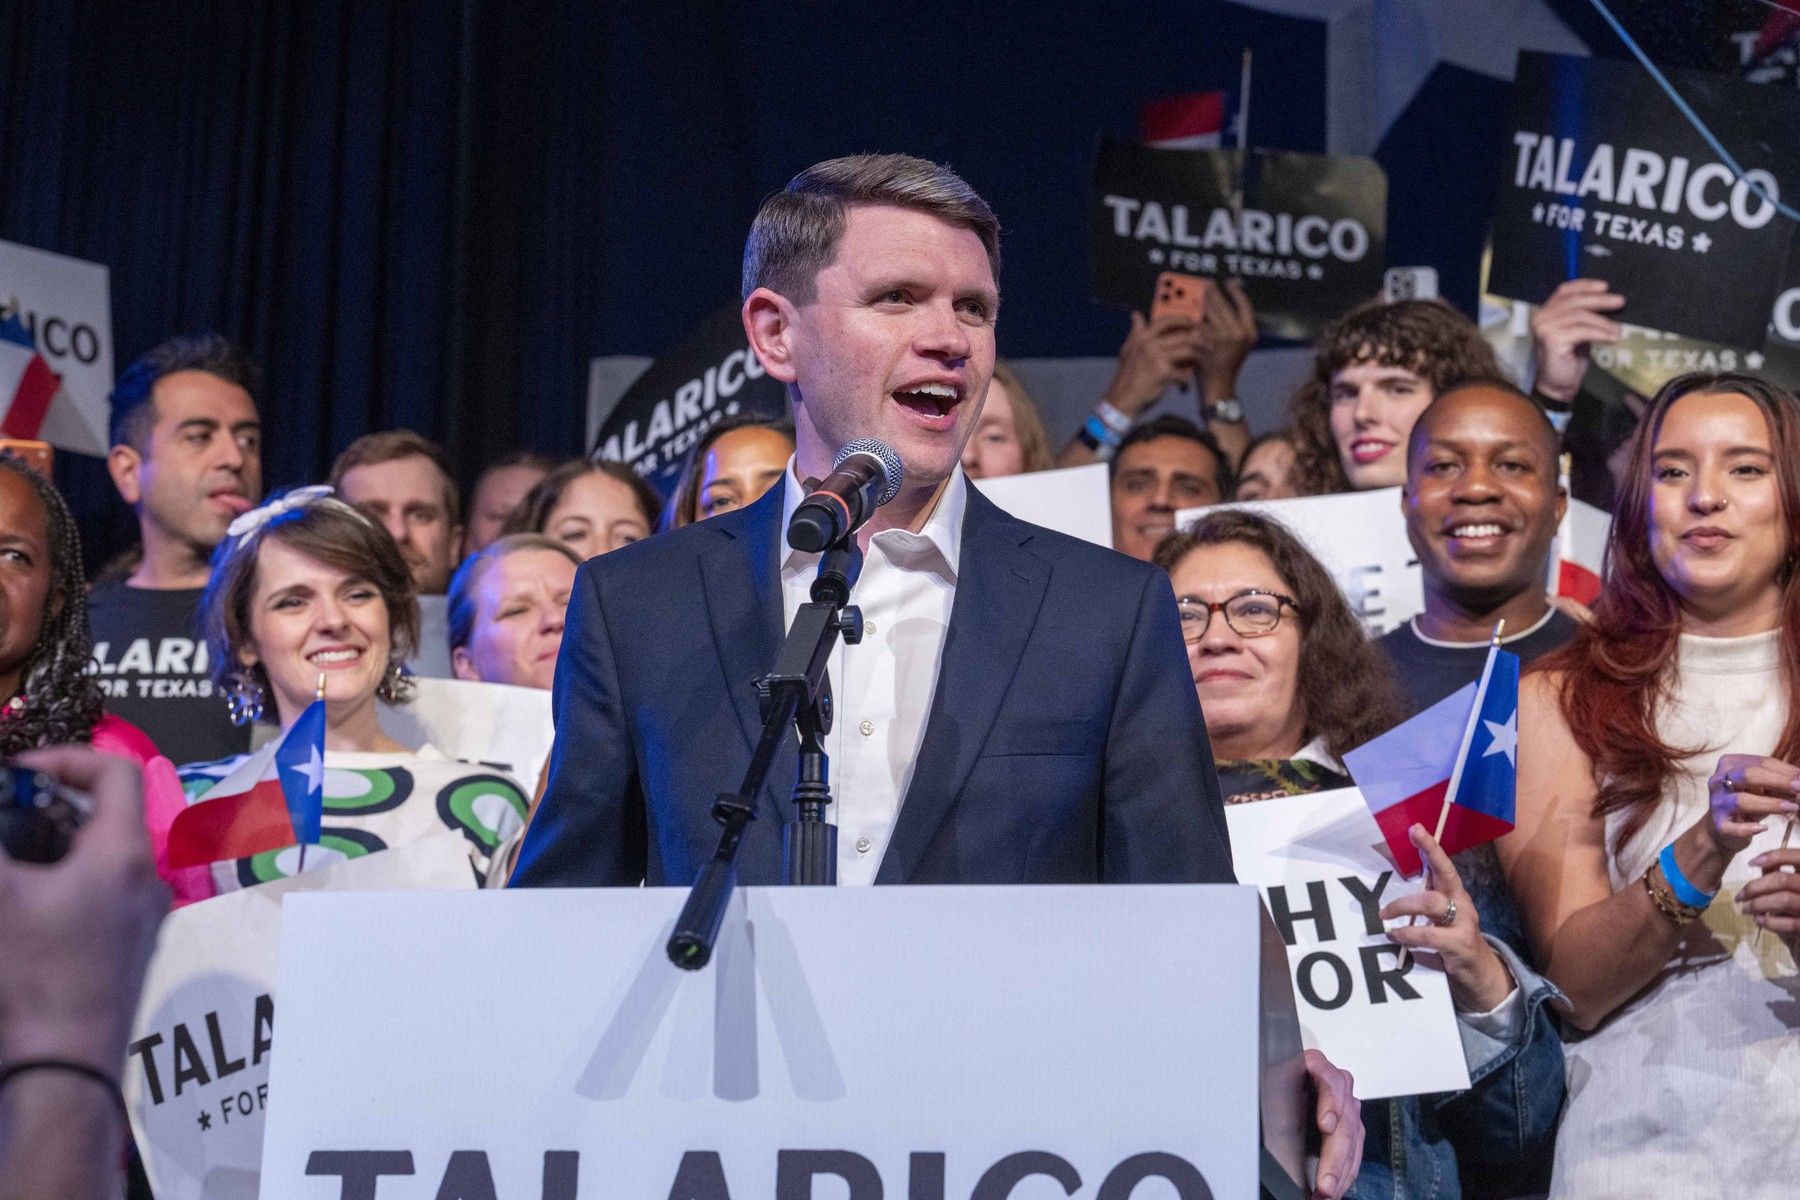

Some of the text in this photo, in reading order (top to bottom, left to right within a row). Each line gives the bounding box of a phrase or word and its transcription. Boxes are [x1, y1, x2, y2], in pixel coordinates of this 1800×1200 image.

[1513, 131, 1780, 229] TALARICO
[1103, 194, 1369, 263] TALARICO
[1546, 203, 1685, 250] FOR TEXAS
[1169, 250, 1302, 280] FOR TEXAS
[1645, 349, 1738, 371] TEXAS
[136, 679, 213, 698] TEXAS
